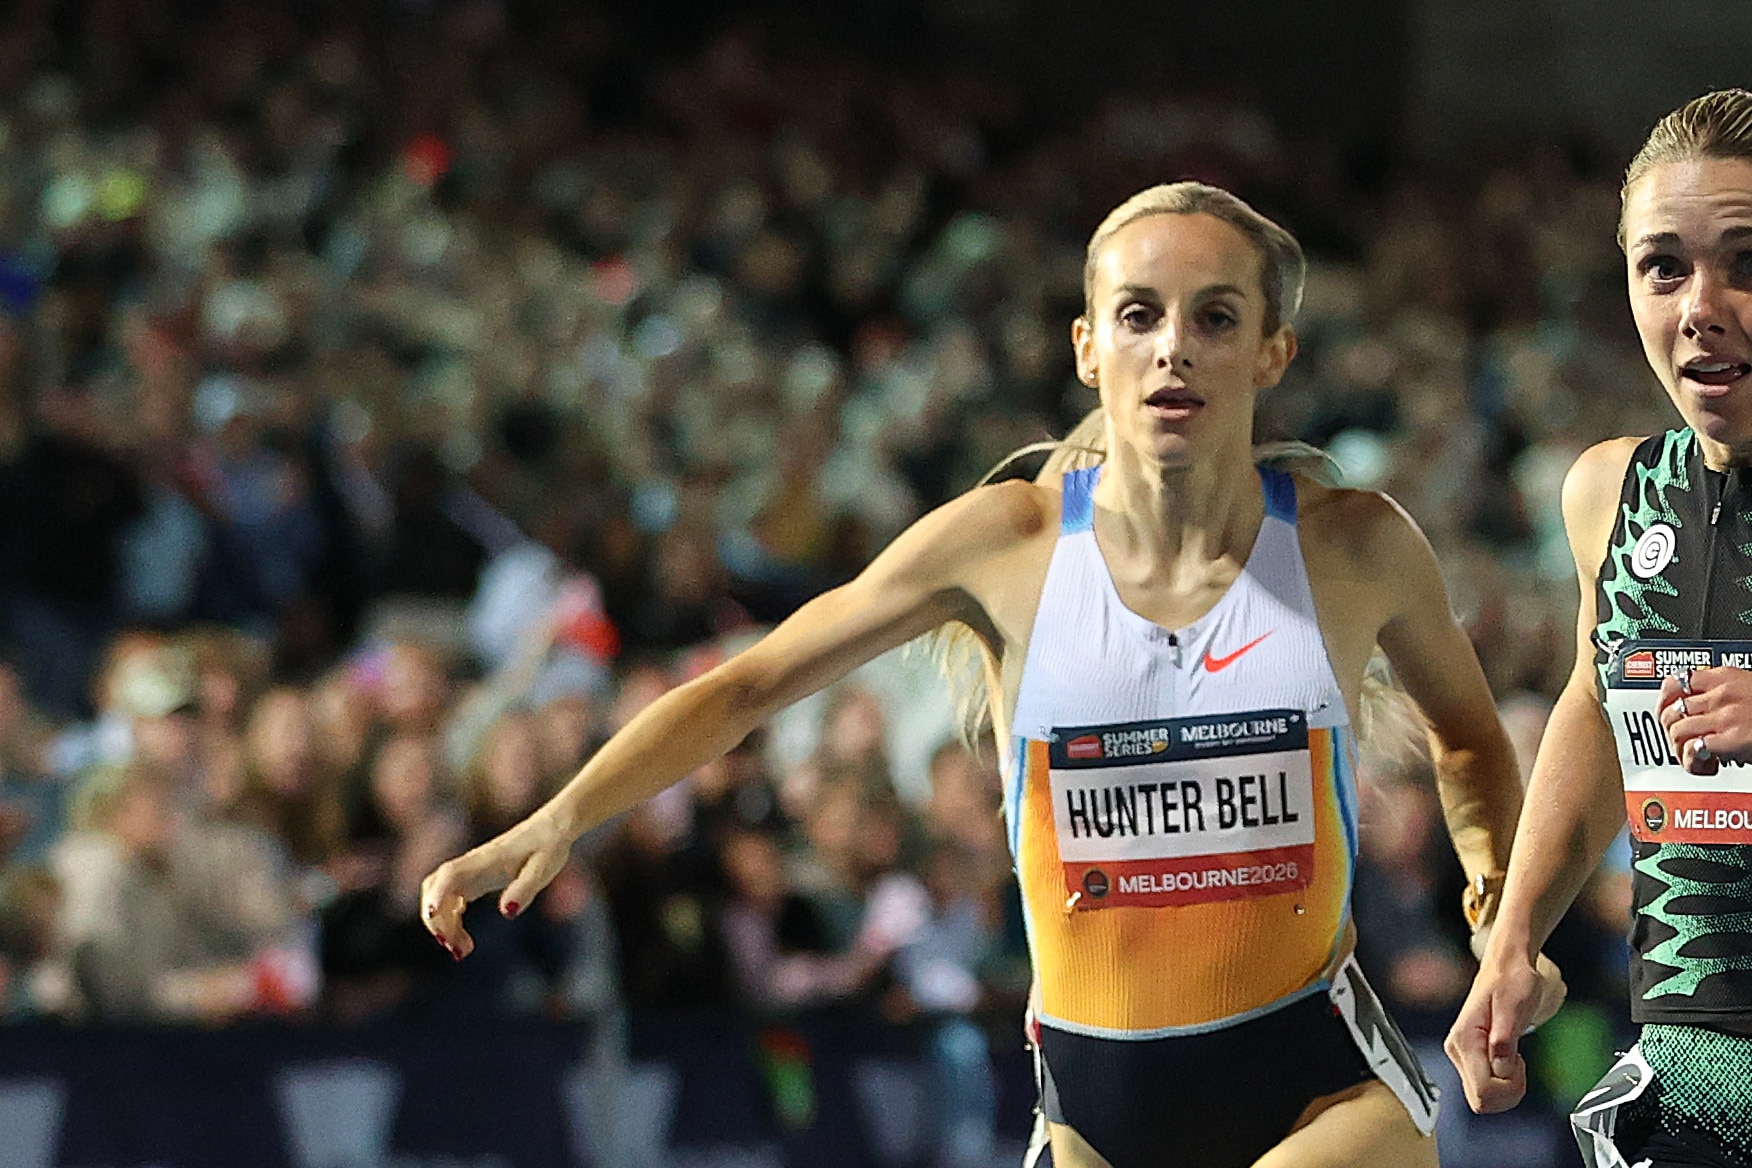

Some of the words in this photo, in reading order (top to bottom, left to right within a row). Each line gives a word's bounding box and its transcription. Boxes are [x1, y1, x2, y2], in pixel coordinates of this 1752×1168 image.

[1655, 651, 1711, 665] SUMMER
[1103, 727, 1169, 744] SUMMER
[1180, 717, 1288, 743] MELBOURNE
[1103, 742, 1153, 758] SERIES
[1066, 780, 1207, 838] HUNTER
[1216, 771, 1299, 829] BELL
[1118, 861, 1298, 893] MELBOURNE2026
